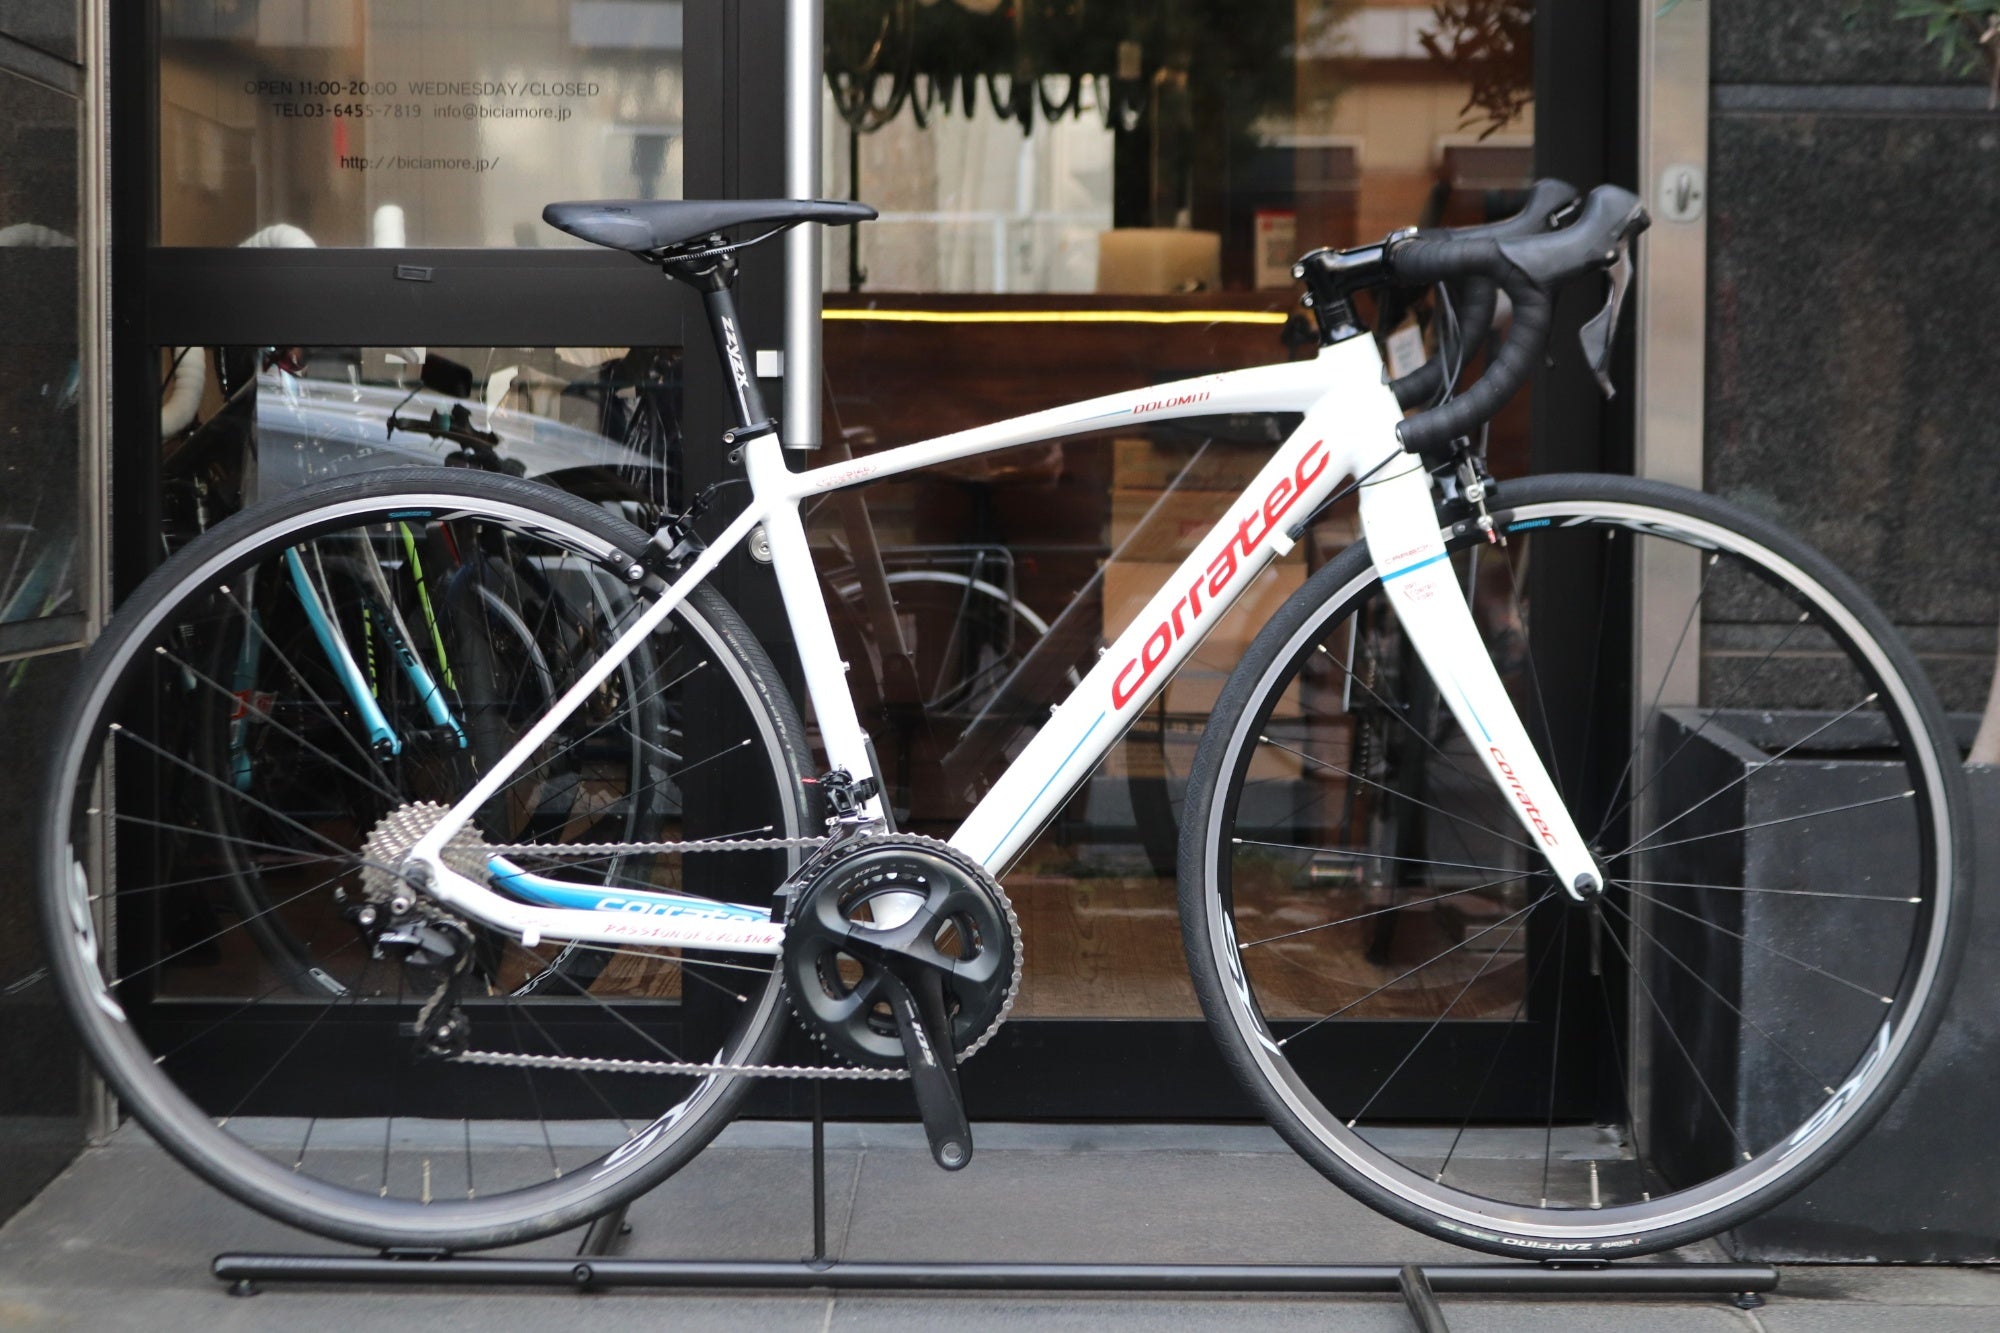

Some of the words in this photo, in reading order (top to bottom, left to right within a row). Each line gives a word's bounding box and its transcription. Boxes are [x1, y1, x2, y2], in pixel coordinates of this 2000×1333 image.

[244, 81, 292, 95] OPEN
[299, 81, 397, 95] 11:00-20:00
[408, 81, 600, 97] WEDNESDAY/CLOSED
[273, 103, 422, 118] TEL03-6455-7819
[433, 103, 572, 121] info@biciamore.jp
[340, 155, 500, 172] http://biciamore.jp/
[1133, 391, 1210, 415] DOLOMITI
[1111, 439, 1331, 711] corratec
[1490, 747, 1559, 848] corratec
[594, 897, 771, 923] corrate
